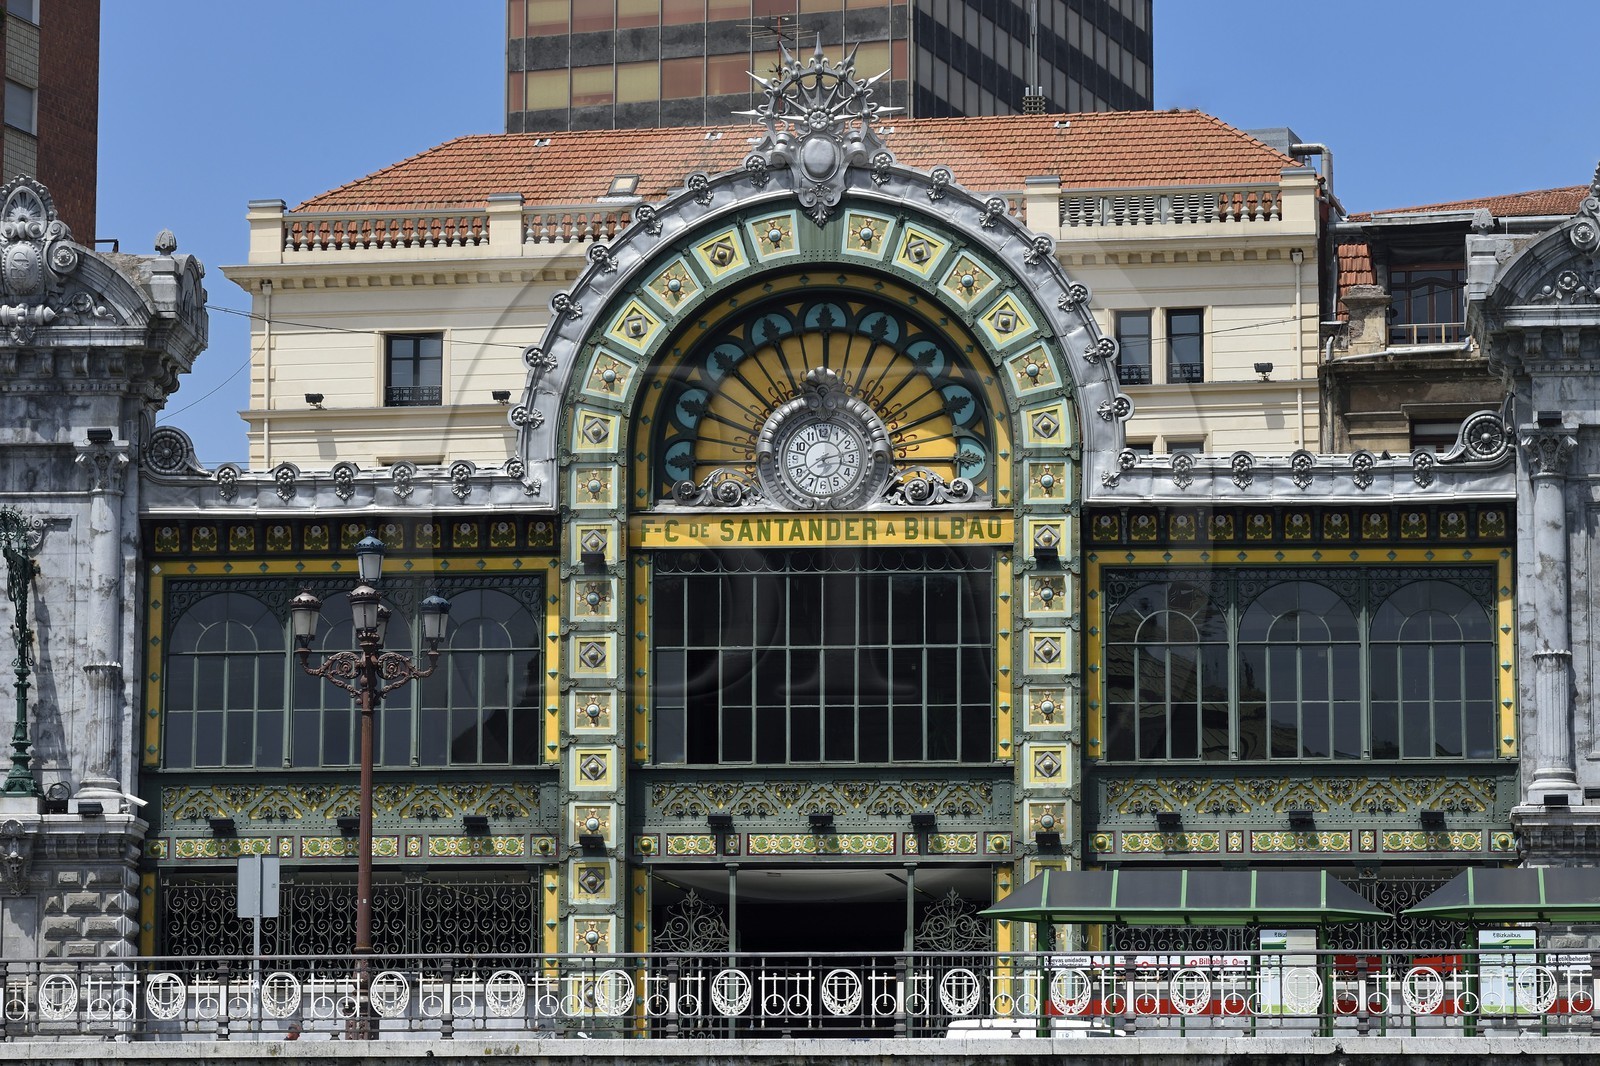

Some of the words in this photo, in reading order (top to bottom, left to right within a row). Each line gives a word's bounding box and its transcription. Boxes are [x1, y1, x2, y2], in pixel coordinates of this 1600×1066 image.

[806, 431, 815, 441] 11
[818, 428, 828, 438] 12
[834, 431, 839, 440] 1
[795, 442, 806, 452] 10
[844, 440, 851, 450] 2
[848, 454, 855, 463] 3
[843, 467, 850, 476] 4
[807, 477, 814, 487] 7
[819, 480, 826, 490] 6
[832, 477, 840, 486] 5
[689, 523, 710, 538] DE
[719, 516, 878, 542] SANTANDER
[885, 522, 896, 537] A
[904, 515, 1002, 541] BILBAO
